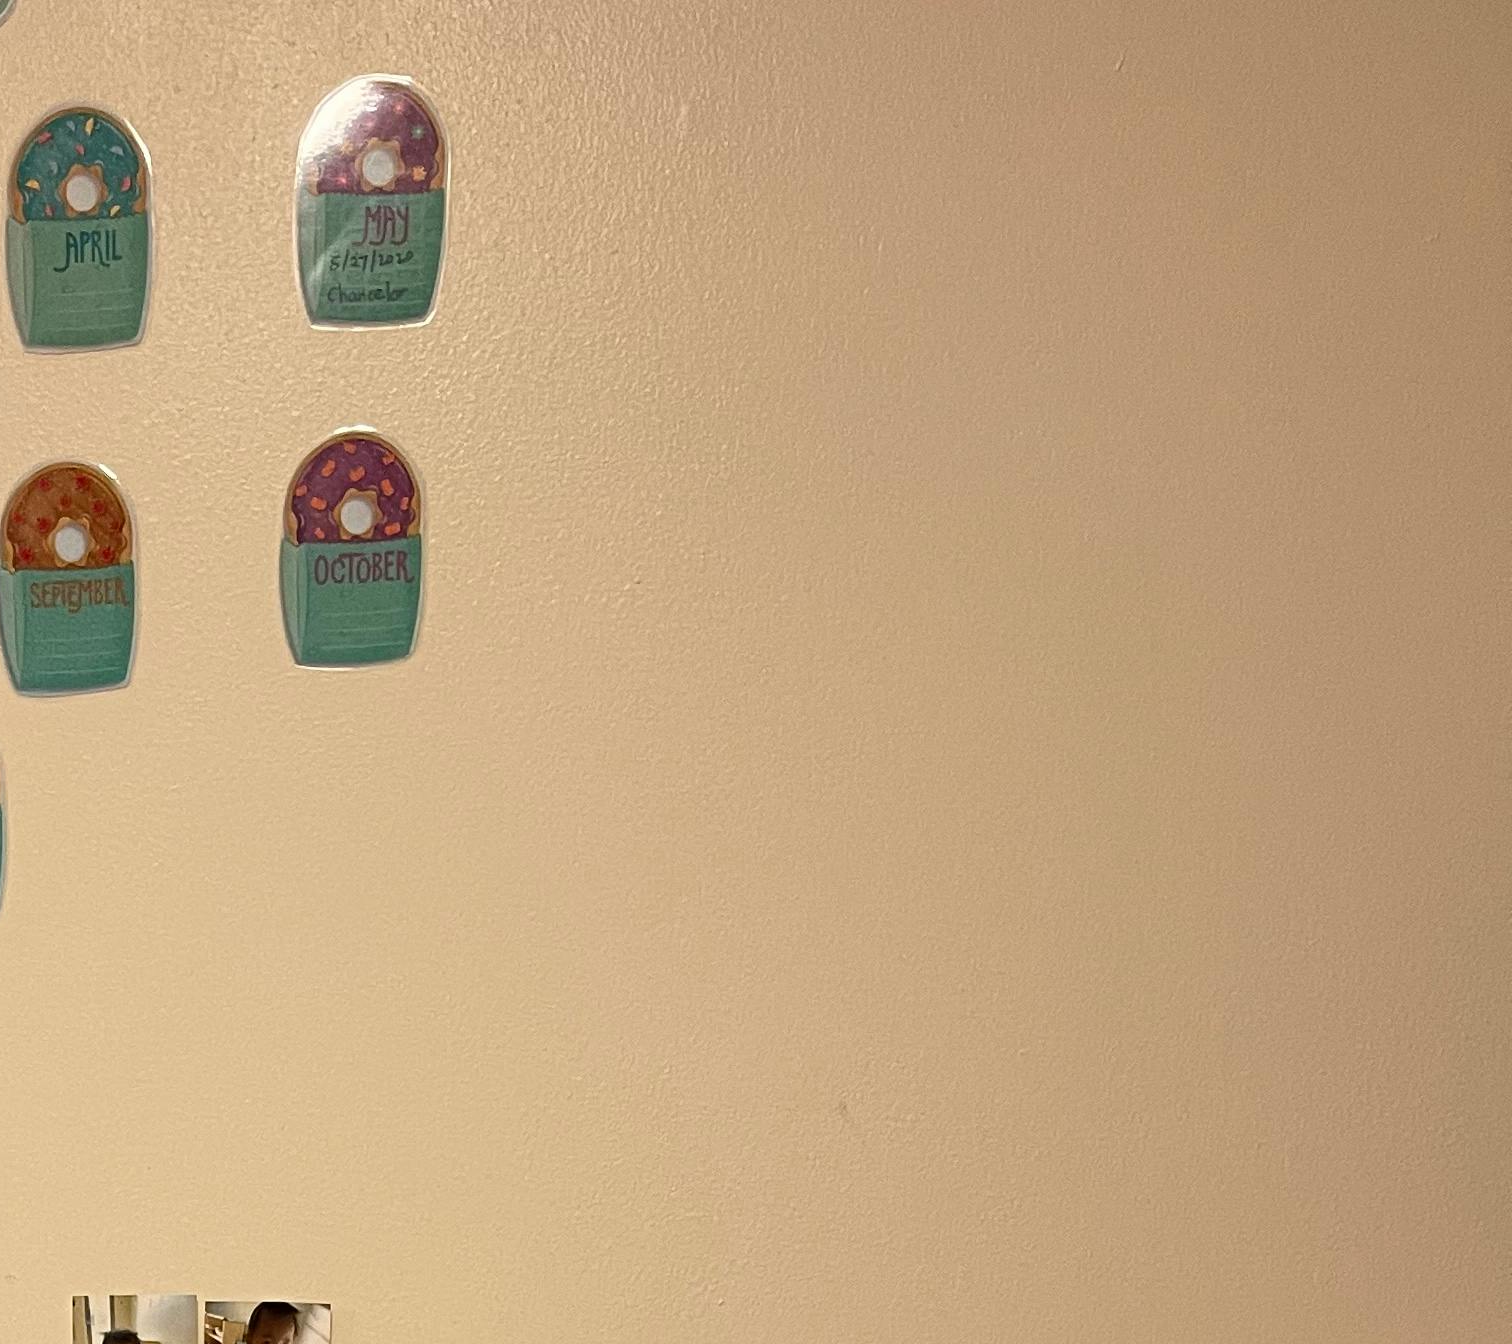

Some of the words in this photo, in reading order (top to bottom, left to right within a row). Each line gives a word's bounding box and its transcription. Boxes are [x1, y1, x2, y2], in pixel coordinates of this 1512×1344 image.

[352, 204, 409, 247] MAY
[53, 229, 123, 273] APRIL
[314, 550, 415, 586] OCTOBER
[30, 576, 131, 615] SEPTEMBER
